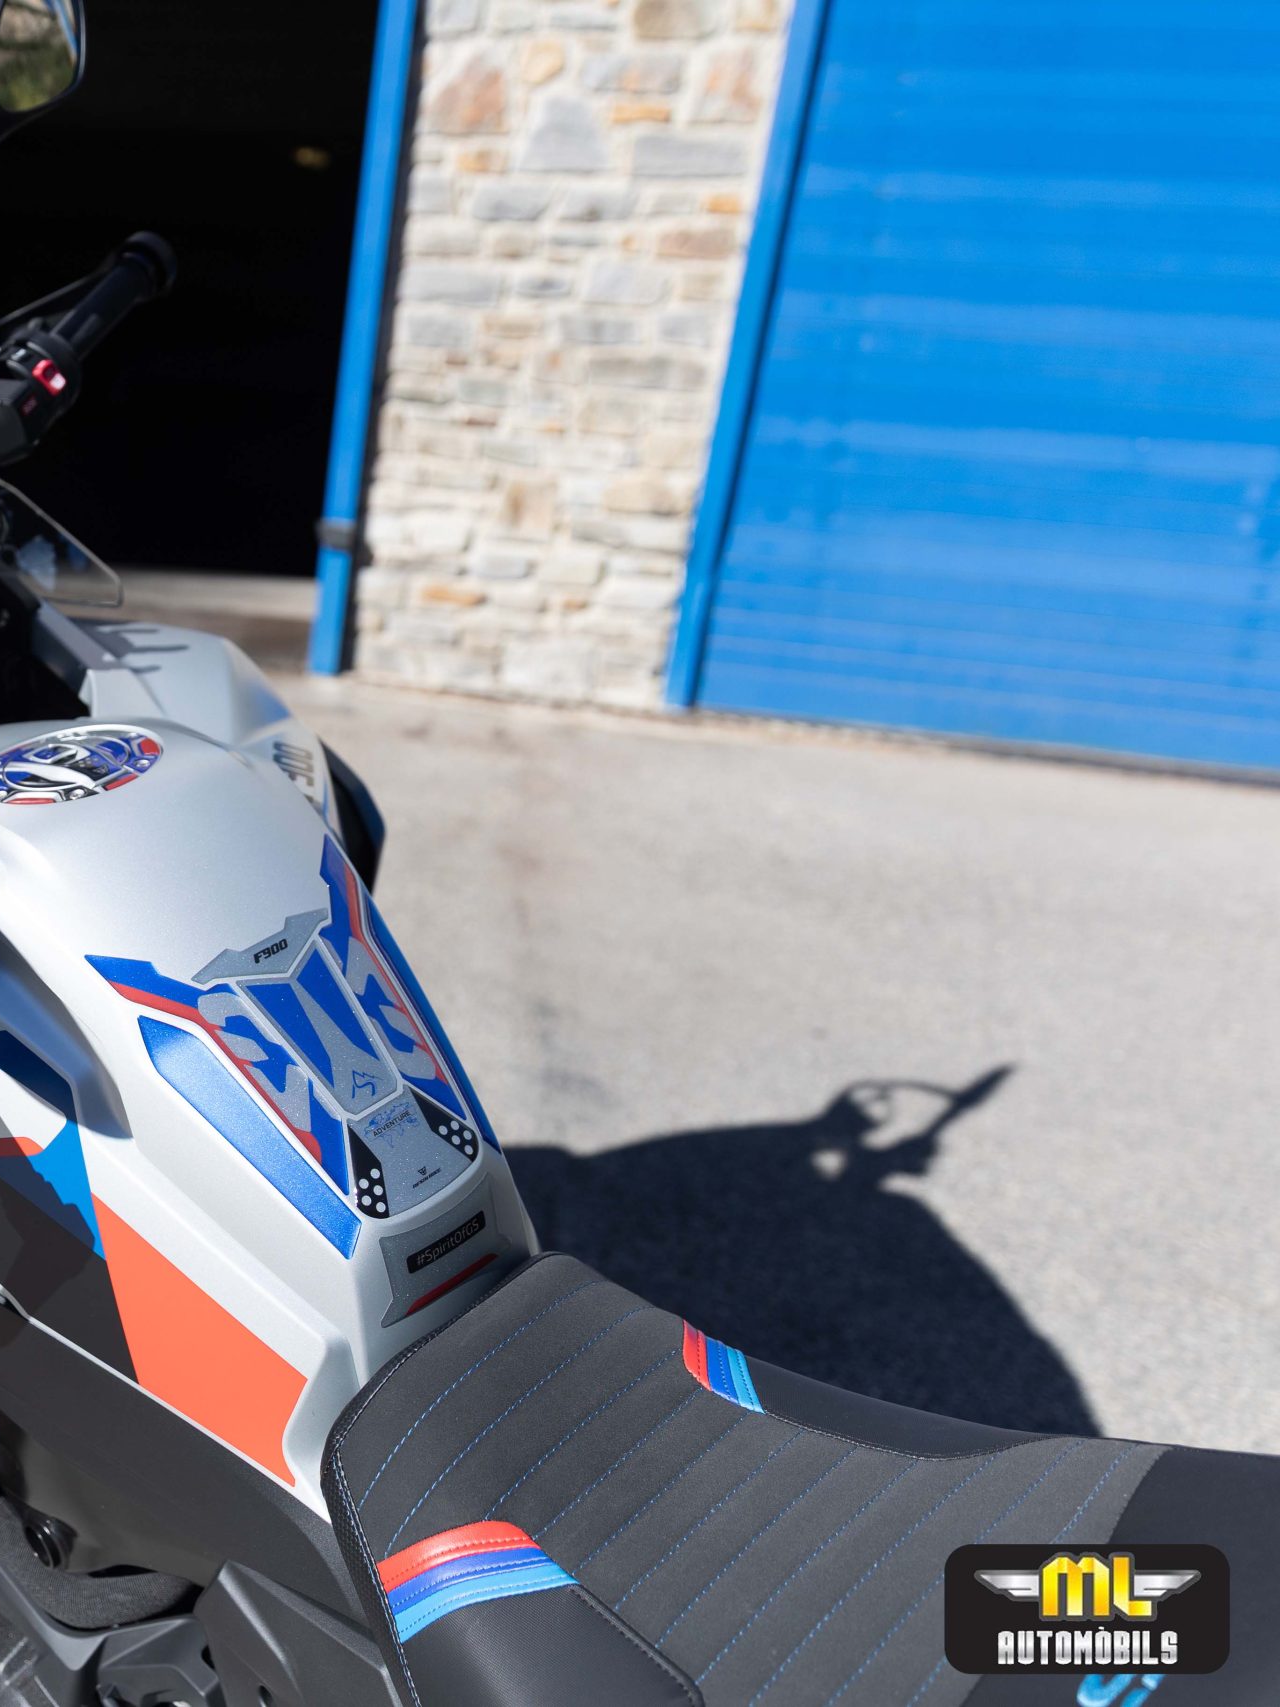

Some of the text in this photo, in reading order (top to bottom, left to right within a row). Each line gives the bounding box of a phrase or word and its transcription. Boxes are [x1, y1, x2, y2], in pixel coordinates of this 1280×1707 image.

[253, 938, 289, 964] F900
[372, 1110, 412, 1137] ADVENTURE
[417, 1218, 479, 1266] #SpiritOfGS
